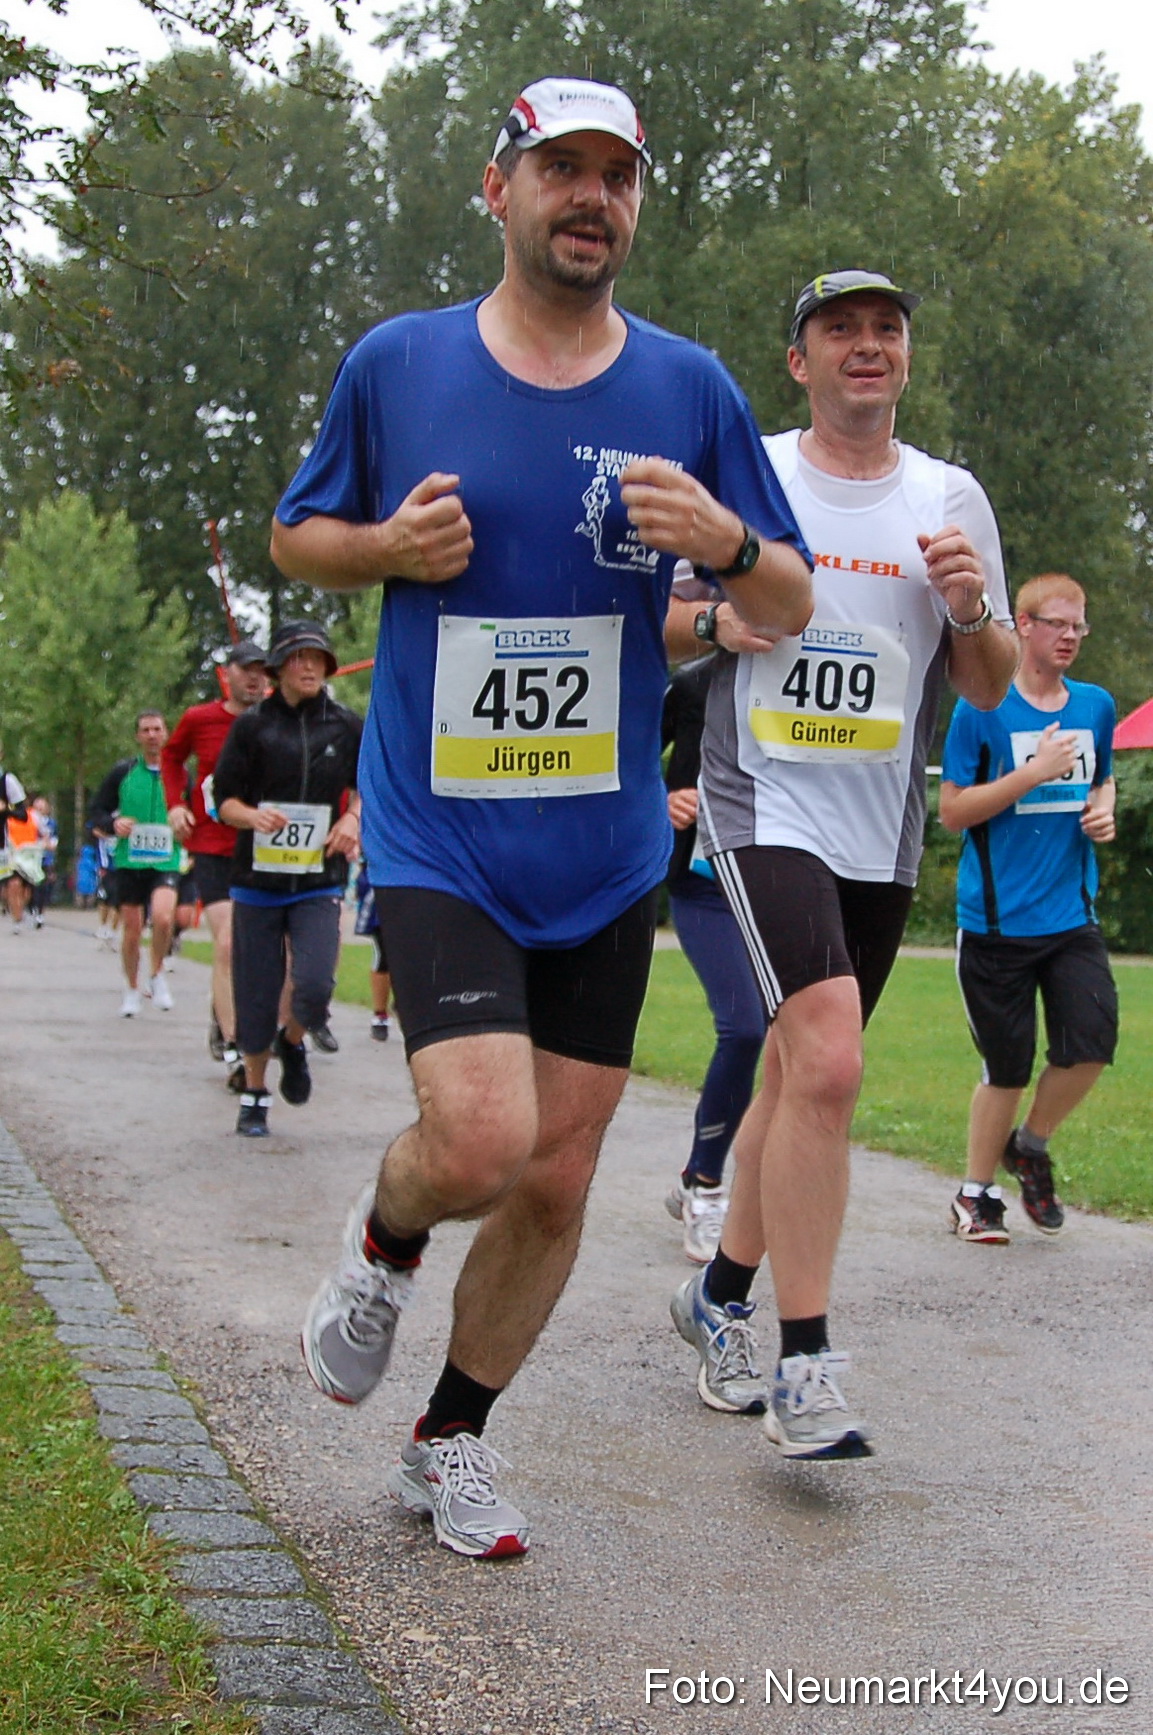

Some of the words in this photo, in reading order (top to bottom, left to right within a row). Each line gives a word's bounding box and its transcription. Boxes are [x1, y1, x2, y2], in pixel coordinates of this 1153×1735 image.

[573, 445, 597, 460] 12.
[813, 553, 908, 579] KLEBL
[495, 629, 571, 648] BOCK
[801, 628, 864, 647] BOCK
[781, 658, 876, 713] 409
[472, 665, 590, 731] 452
[440, 722, 448, 734] D
[791, 720, 858, 744] Günter
[487, 745, 571, 776] Jürgen
[270, 823, 315, 848] 287
